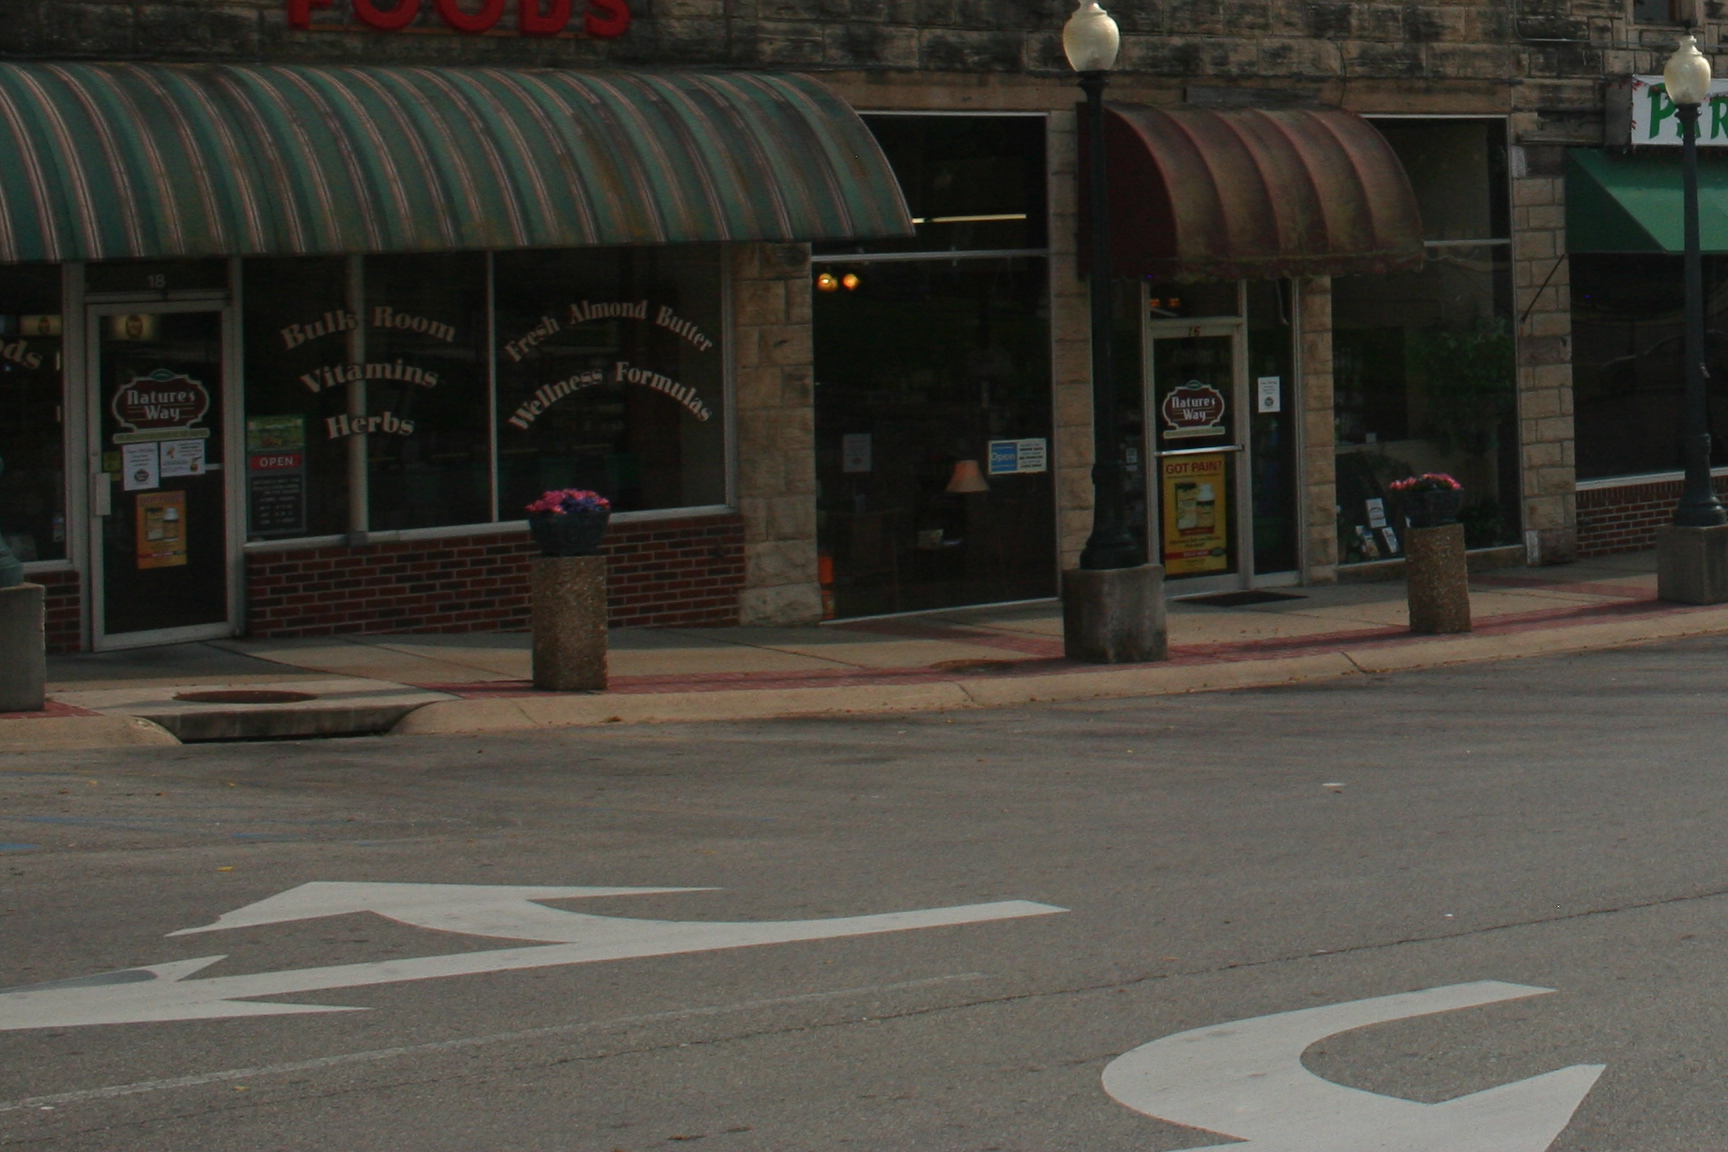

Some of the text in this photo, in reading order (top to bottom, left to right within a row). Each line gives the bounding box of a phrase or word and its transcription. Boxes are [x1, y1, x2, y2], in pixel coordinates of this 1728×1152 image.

[148, 274, 166, 289] 18
[280, 305, 456, 350] Bulk Room
[504, 299, 713, 363] Fresh Almond Butter
[299, 358, 439, 394] Vitamins
[507, 361, 713, 431] Wellness Formulas
[143, 405, 180, 422] Way
[1183, 408, 1207, 422] Way
[325, 411, 416, 440] Herbs
[259, 455, 294, 468] OPEN
[1165, 460, 1223, 475] GOT PAIN?
